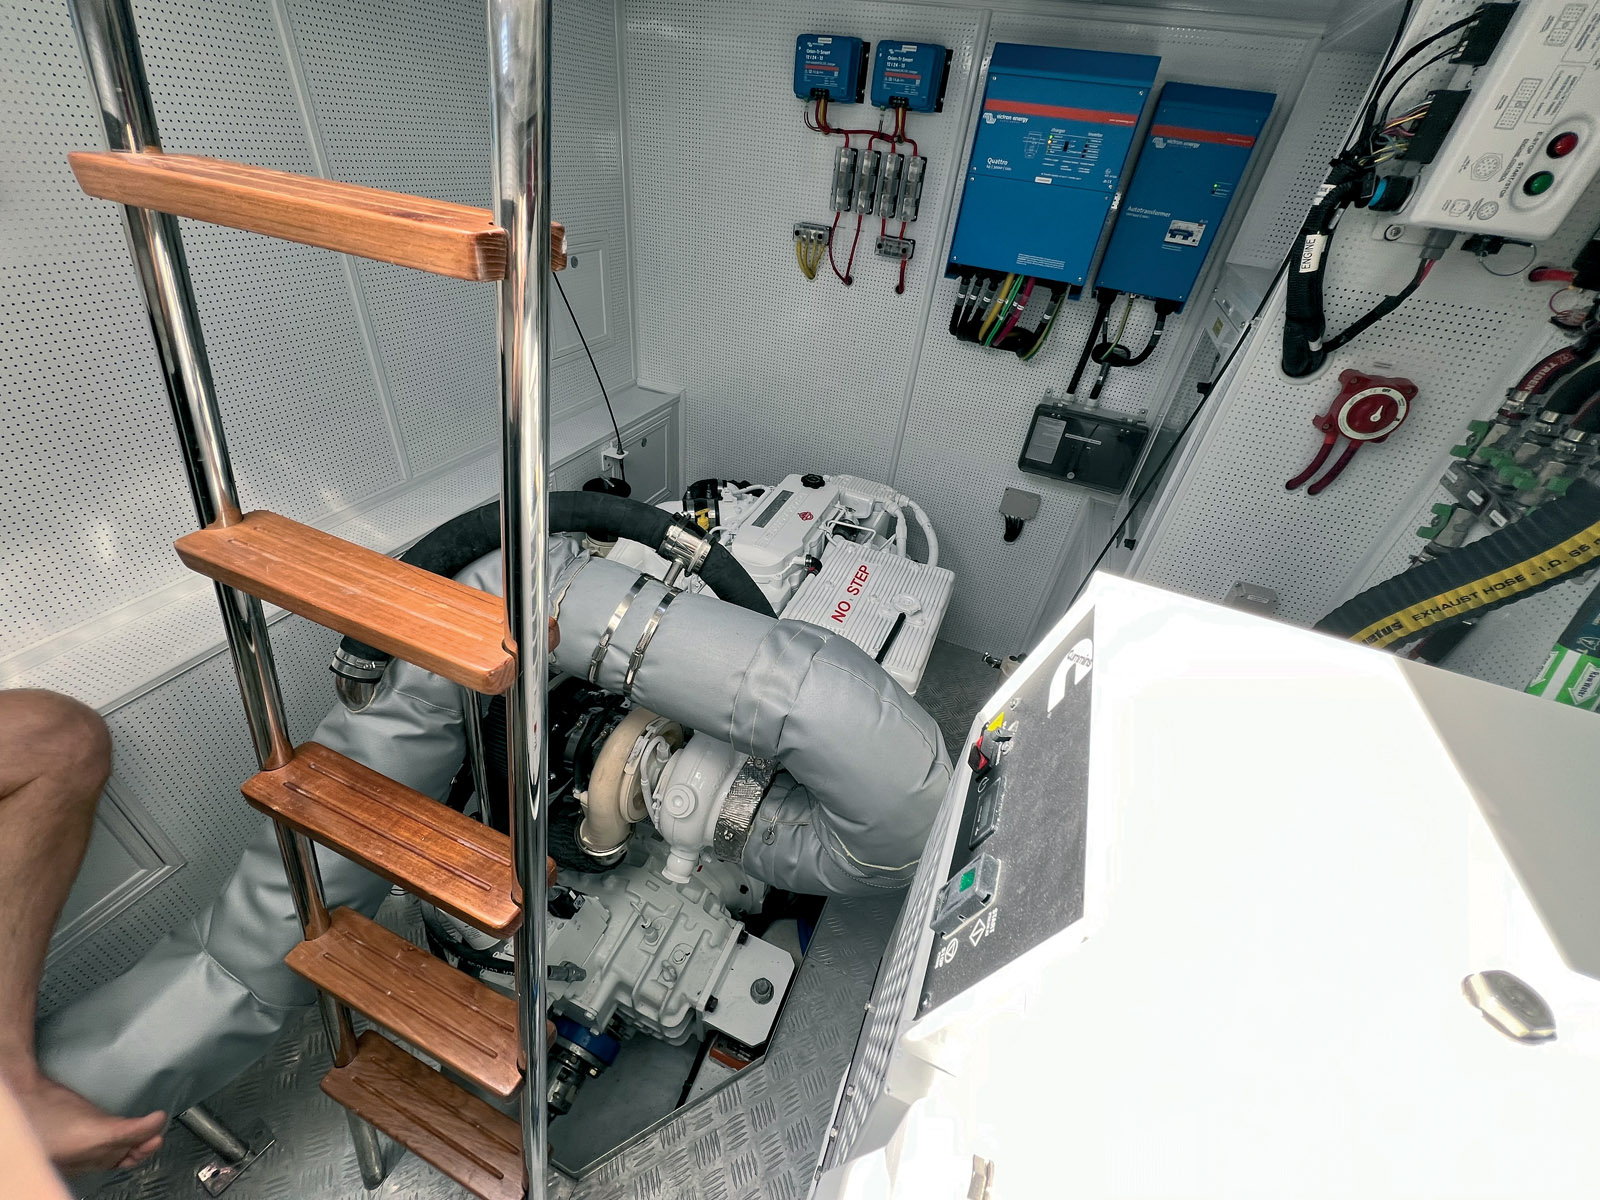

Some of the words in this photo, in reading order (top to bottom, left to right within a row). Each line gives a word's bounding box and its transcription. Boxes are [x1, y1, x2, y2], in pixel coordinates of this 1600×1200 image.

[1012, 116, 1029, 124] energy
[987, 157, 1008, 166] Quattro
[1127, 205, 1171, 218] Autotransformer
[1301, 238, 1316, 270] ENGINE
[831, 600, 851, 623] NO
[846, 564, 870, 596] STEP
[1411, 592, 1479, 622] EXHAUST
[1482, 574, 1527, 596] HOSE
